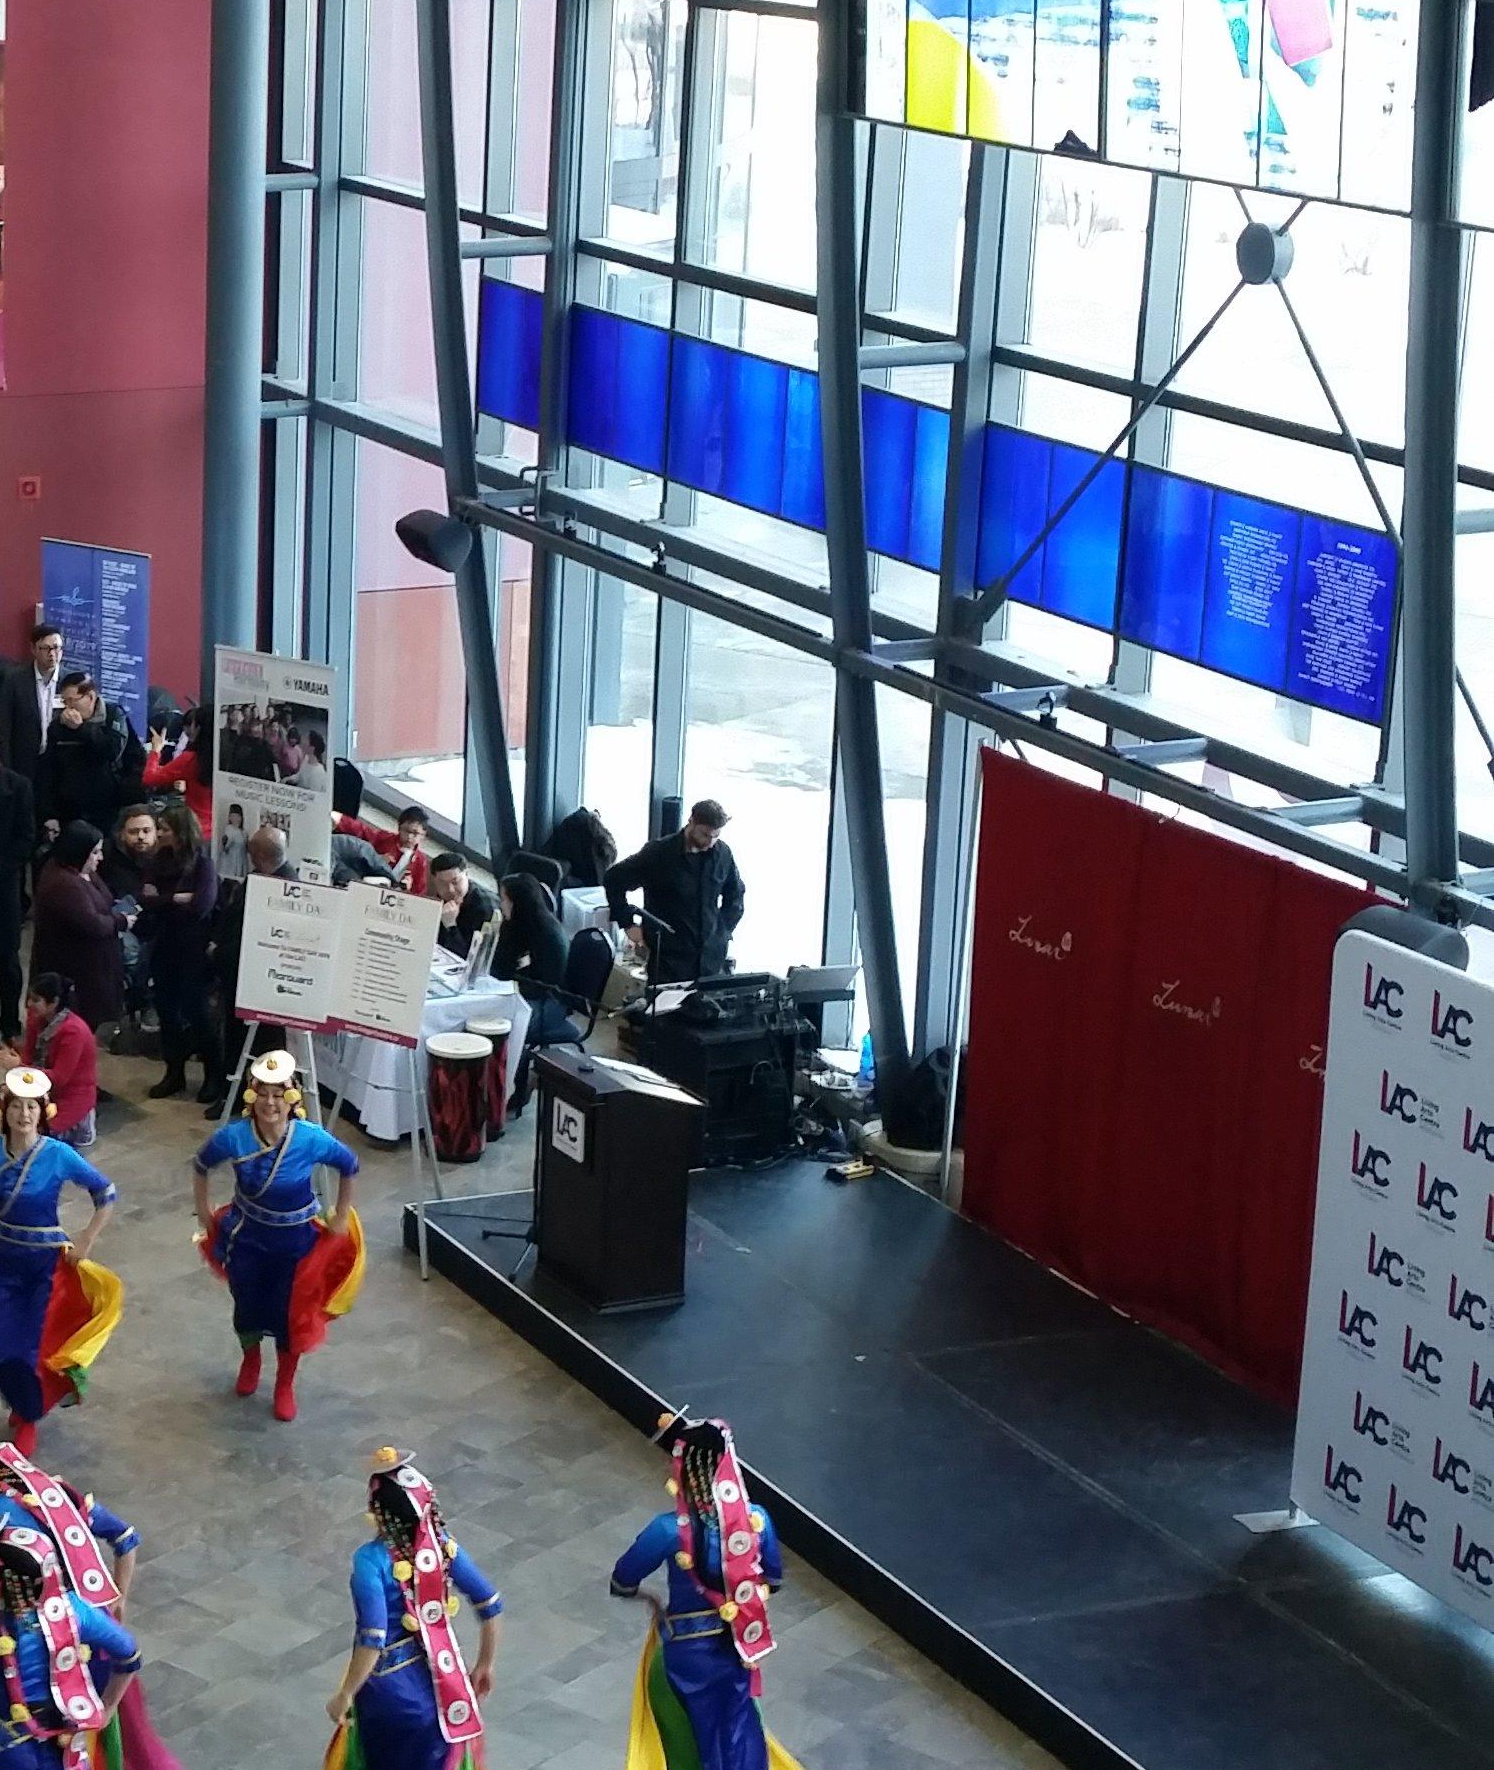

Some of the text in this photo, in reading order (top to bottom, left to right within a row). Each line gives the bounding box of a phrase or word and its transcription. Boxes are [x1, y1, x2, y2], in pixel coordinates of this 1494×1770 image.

[293, 679, 329, 696] YAMAHA
[236, 789, 263, 804] MUSIC
[271, 785, 295, 798] NOW
[297, 789, 314, 803] FOR
[284, 883, 300, 898] LAC
[380, 890, 396, 907] LAC
[1365, 963, 1404, 1017] LAC
[1432, 990, 1473, 1047] LAC
[1381, 1069, 1417, 1123] LAC
[557, 1103, 577, 1142] LAC
[1418, 1161, 1458, 1220] LAC
[1368, 1231, 1404, 1287] LAC
[1404, 1325, 1443, 1383] LAC
